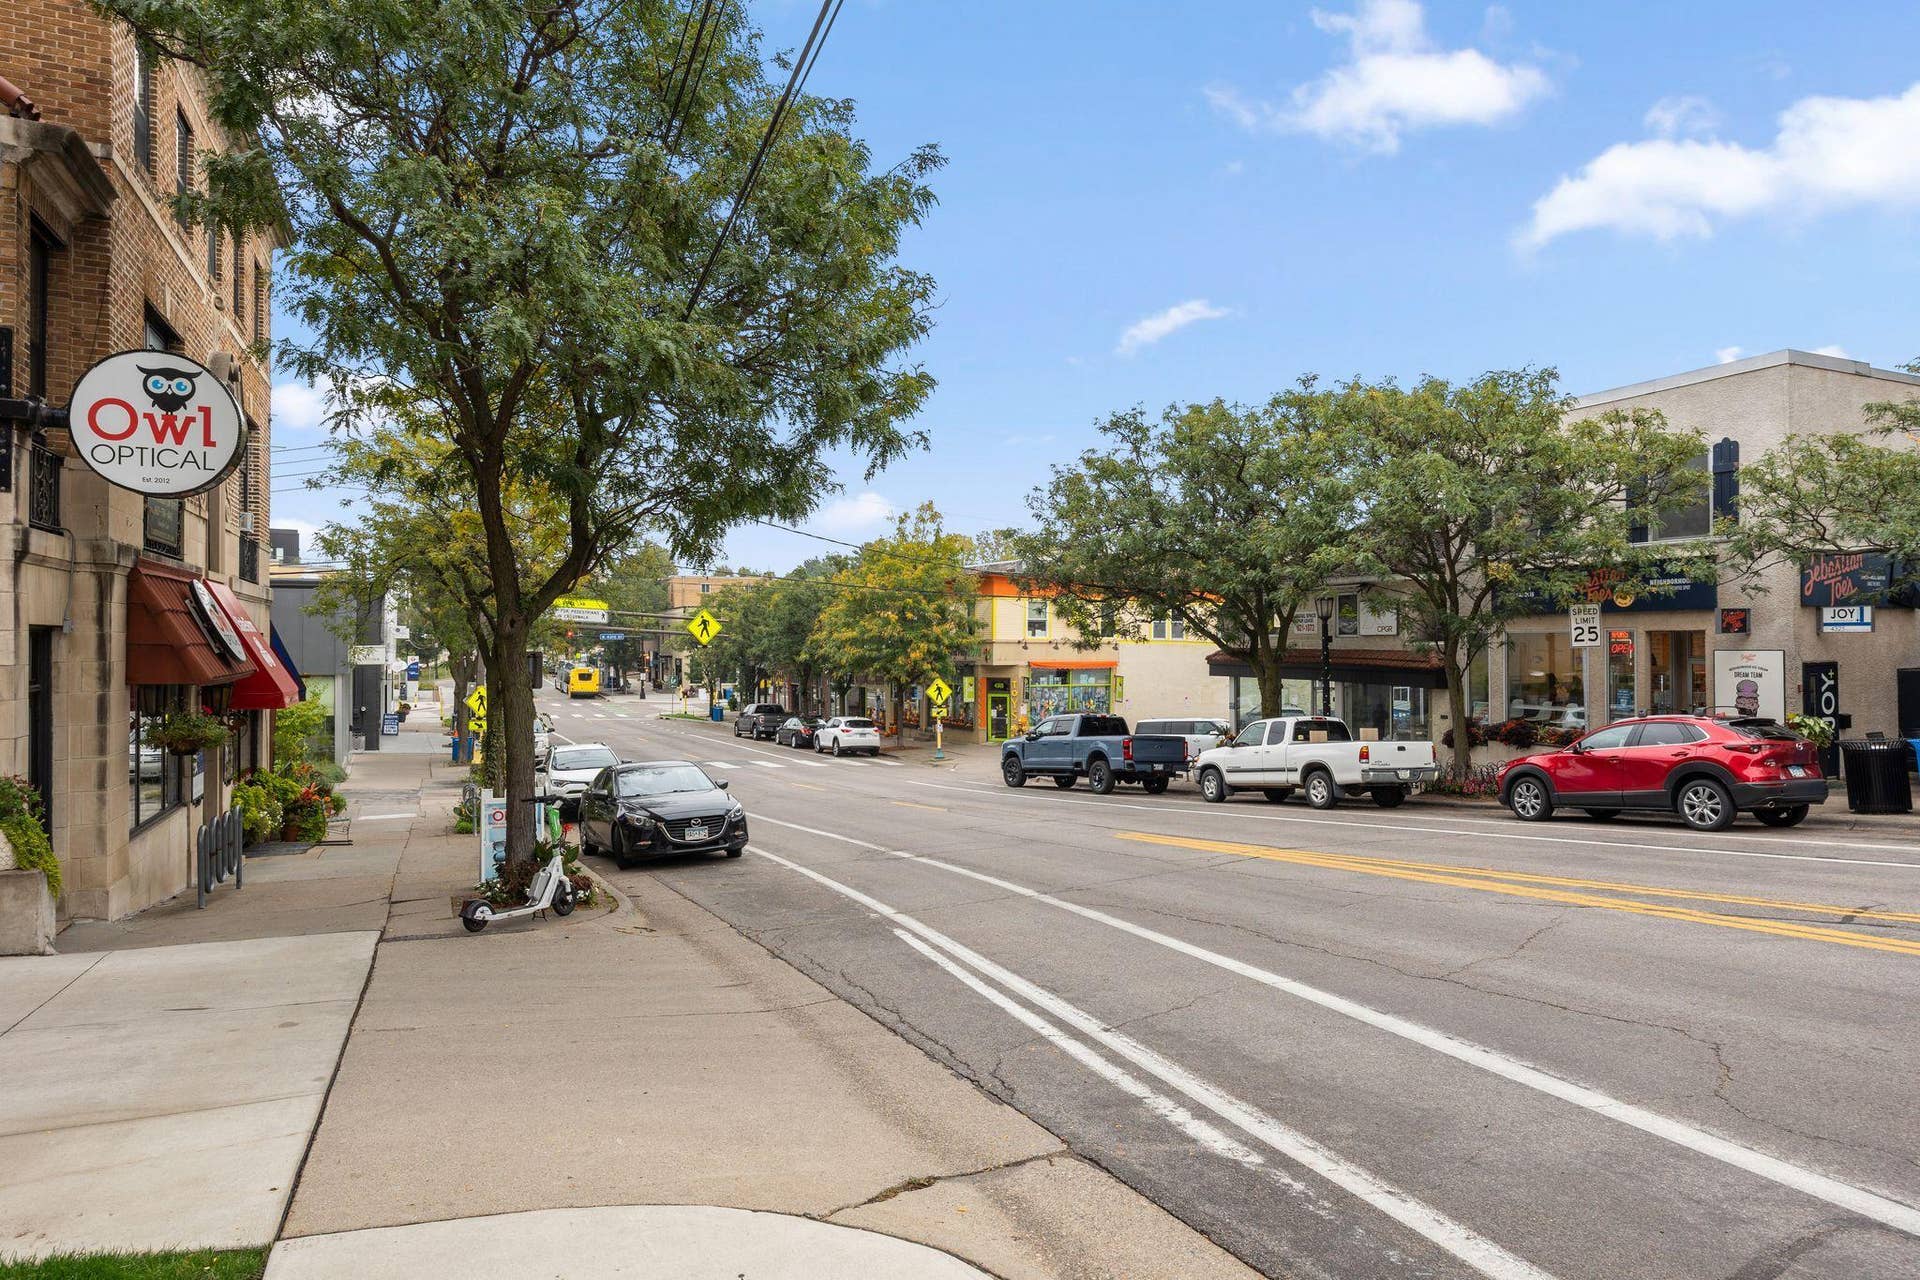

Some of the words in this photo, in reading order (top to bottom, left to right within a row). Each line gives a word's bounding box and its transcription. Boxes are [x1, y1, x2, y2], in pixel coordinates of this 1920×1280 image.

[88, 397, 216, 448] Owl
[91, 443, 216, 471] OPTICAL
[1572, 607, 1598, 616] SPEED
[1830, 609, 1855, 619] JOY
[1574, 626, 1599, 642] 25
